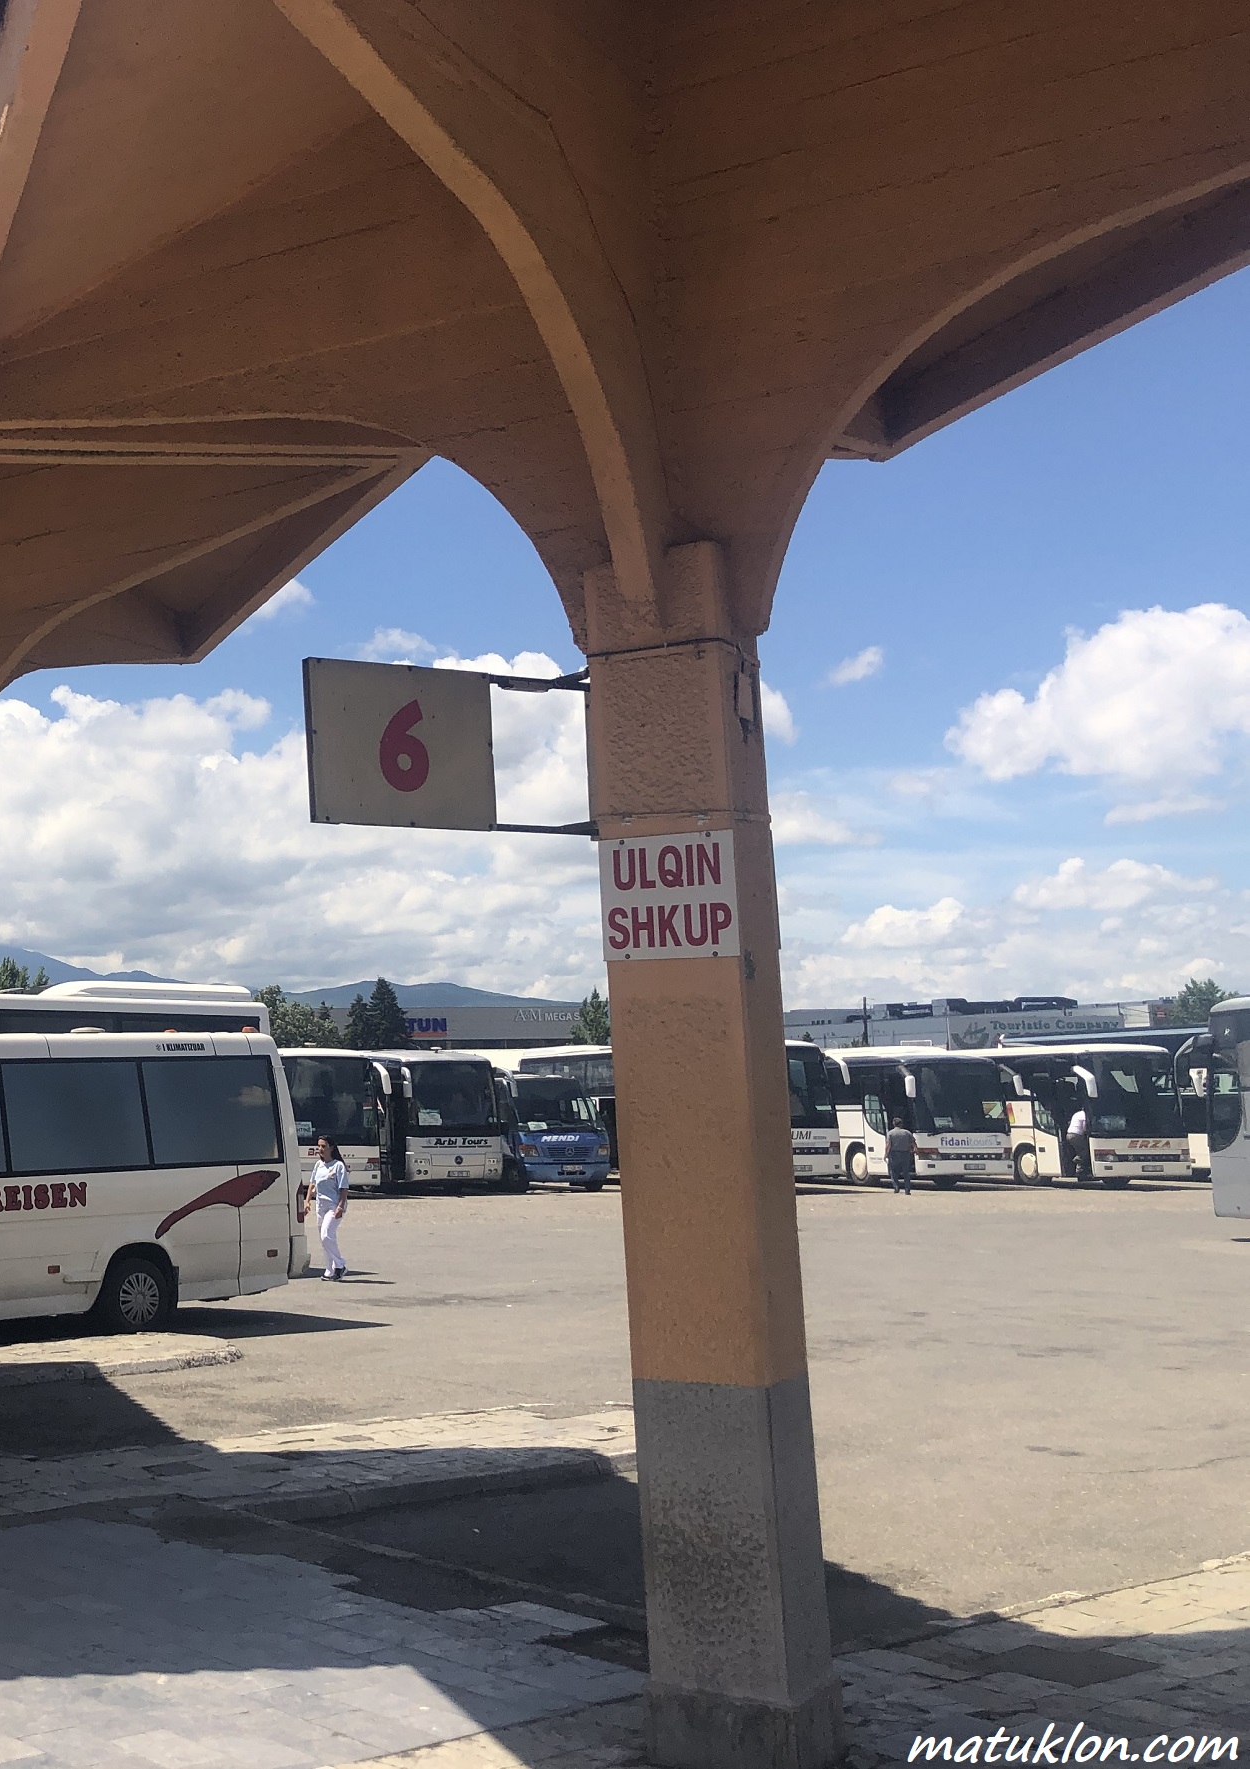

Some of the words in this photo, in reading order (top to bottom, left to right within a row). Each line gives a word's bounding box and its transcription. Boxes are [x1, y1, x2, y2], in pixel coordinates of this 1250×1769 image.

[379, 698, 430, 793] 6
[612, 841, 722, 893] ULQIN
[607, 902, 733, 951] SHKUP
[544, 1012, 572, 1021] MEGA
[540, 1134, 580, 1143] MENDI
[791, 1130, 812, 1140] UMI
[433, 1137, 458, 1146] Arbi
[461, 1137, 489, 1146] Tours
[1127, 1139, 1171, 1149] ERZA
